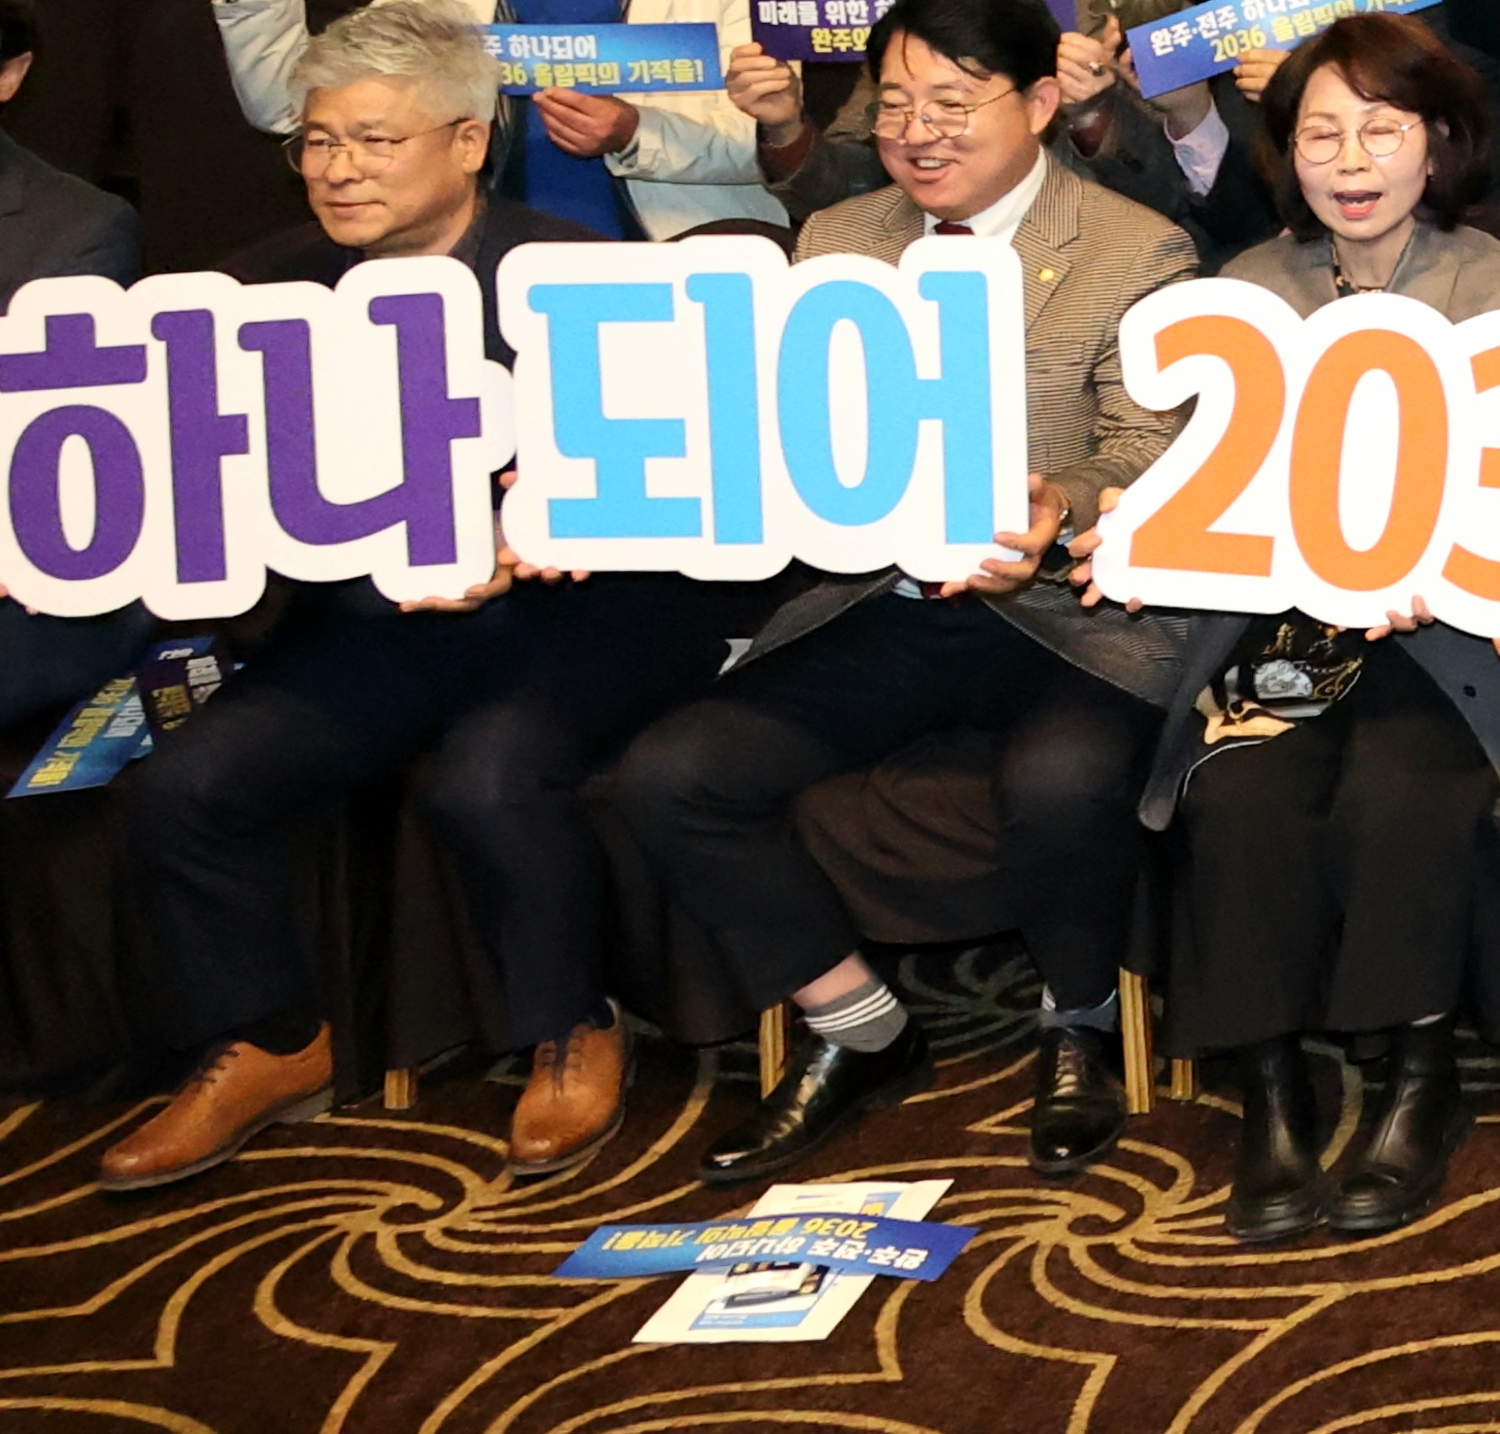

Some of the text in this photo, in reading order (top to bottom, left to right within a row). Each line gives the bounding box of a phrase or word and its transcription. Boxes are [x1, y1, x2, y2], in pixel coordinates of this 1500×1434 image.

[759, 0, 868, 26] 미래를 위한
[1150, 5, 1238, 57] 완주·전주
[1210, 26, 1267, 63] 2036
[509, 36, 598, 60] 하나되어
[534, 60, 703, 86] 올림픽의 기적을!
[0, 270, 994, 583] 하나 되어
[801, 1217, 878, 1240] 2036
[696, 1236, 929, 1270] 완주·전주 하나되어
